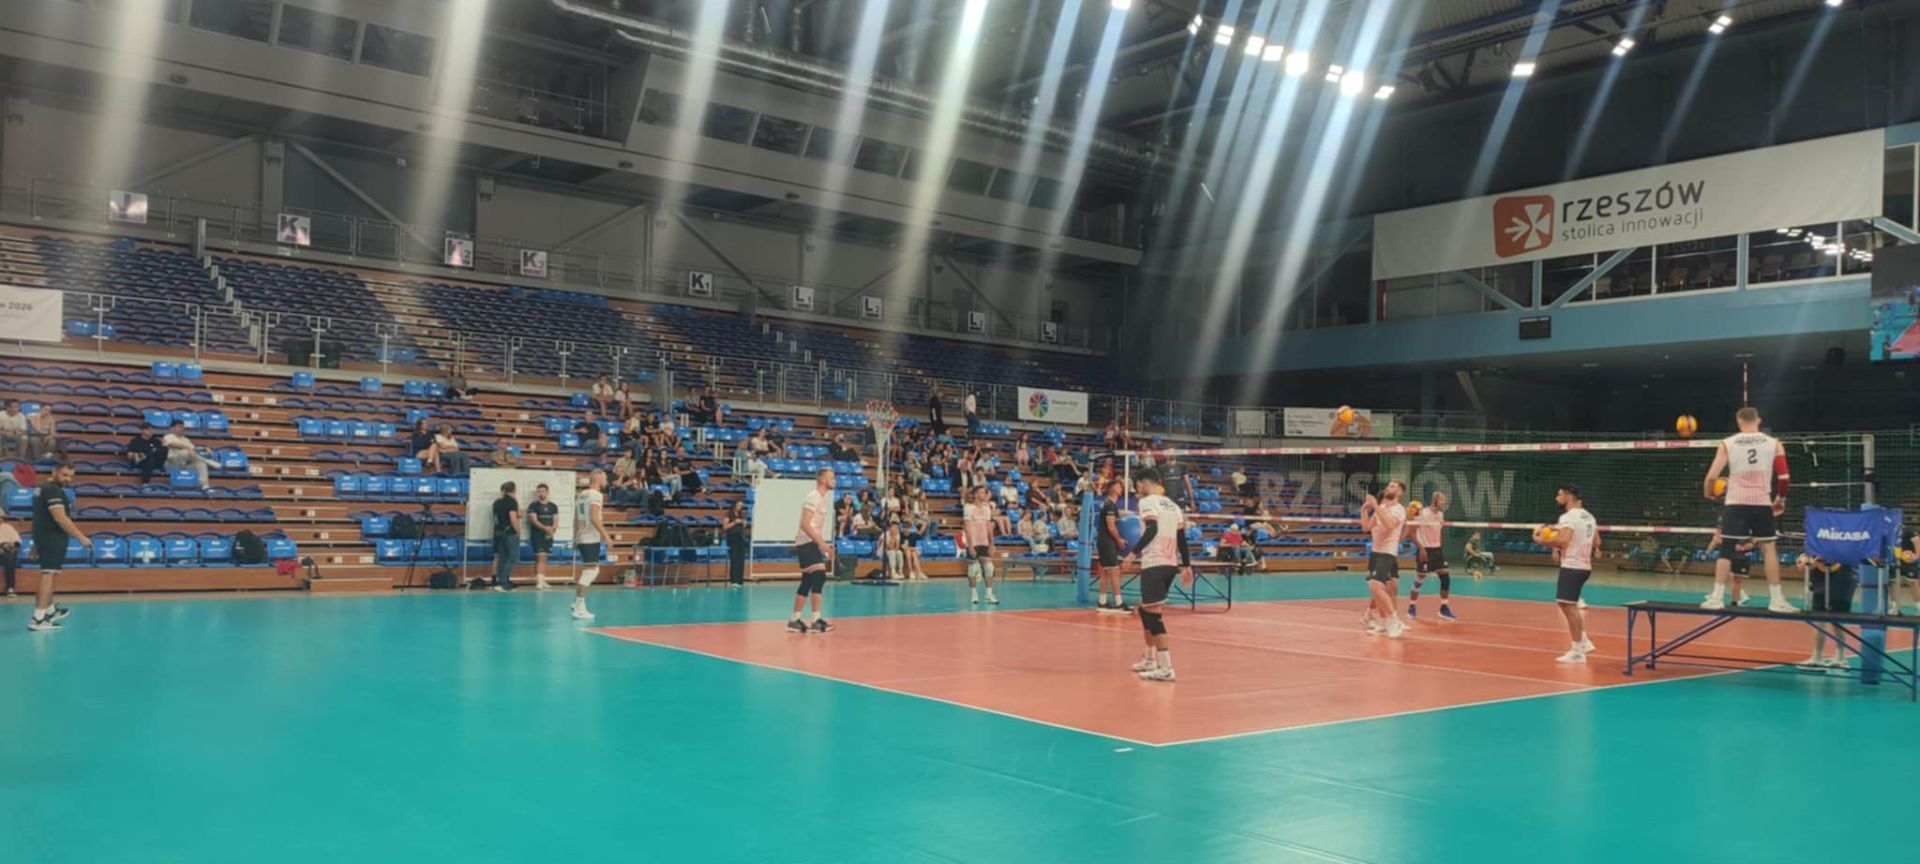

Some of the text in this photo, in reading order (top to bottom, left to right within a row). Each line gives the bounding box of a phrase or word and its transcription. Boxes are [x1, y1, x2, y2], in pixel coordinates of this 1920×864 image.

[1561, 180, 1705, 224] rzeszów
[1562, 207, 1703, 241] stolica innowacji
[522, 251, 545, 269] K2
[691, 273, 710, 289] K1
[8, 301, 33, 311] 2026
[1747, 448, 1758, 465] 2
[1259, 456, 1516, 518] RZESÓW
